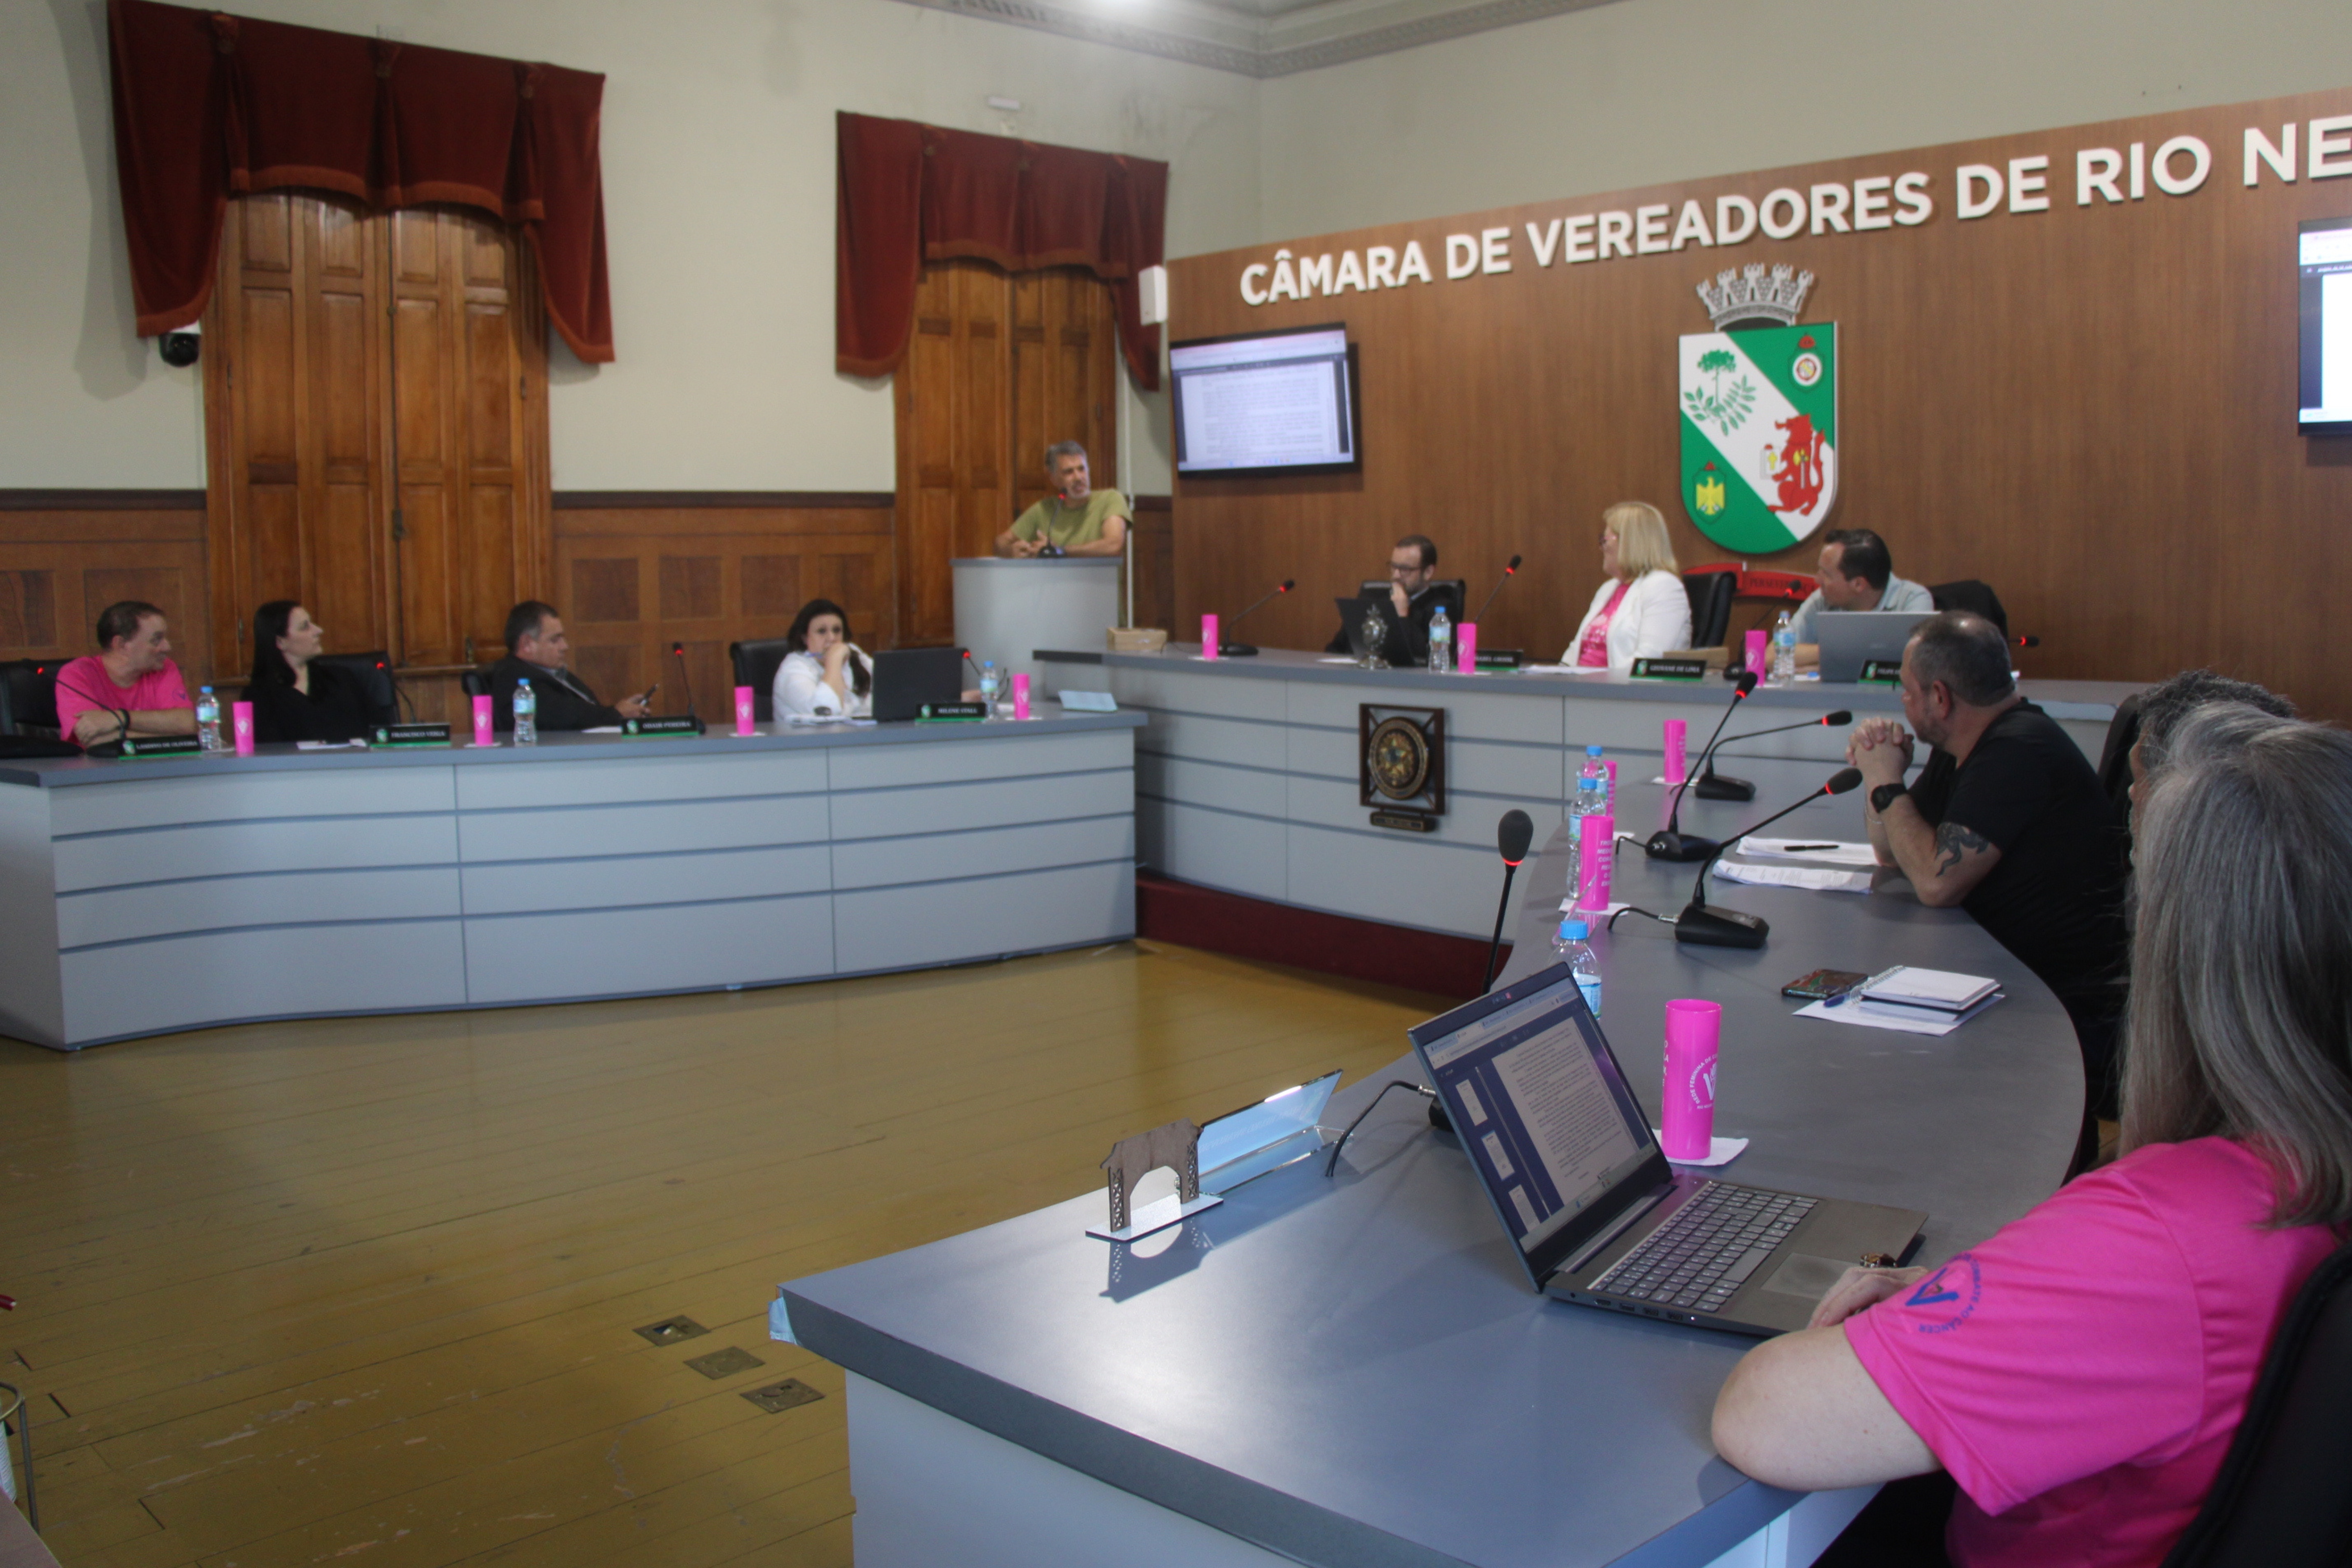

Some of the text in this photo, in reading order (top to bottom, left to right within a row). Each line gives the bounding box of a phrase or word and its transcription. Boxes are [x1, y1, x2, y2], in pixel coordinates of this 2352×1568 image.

[1241, 241, 1432, 304] CÂMARA
[1446, 227, 1511, 279] DE
[1525, 172, 1931, 269] VEREADORES
[1957, 156, 2049, 218] DE
[2077, 135, 2211, 204] RIO
[1690, 1062, 1705, 1088] FEMININA
[1704, 1056, 1712, 1064] DE
